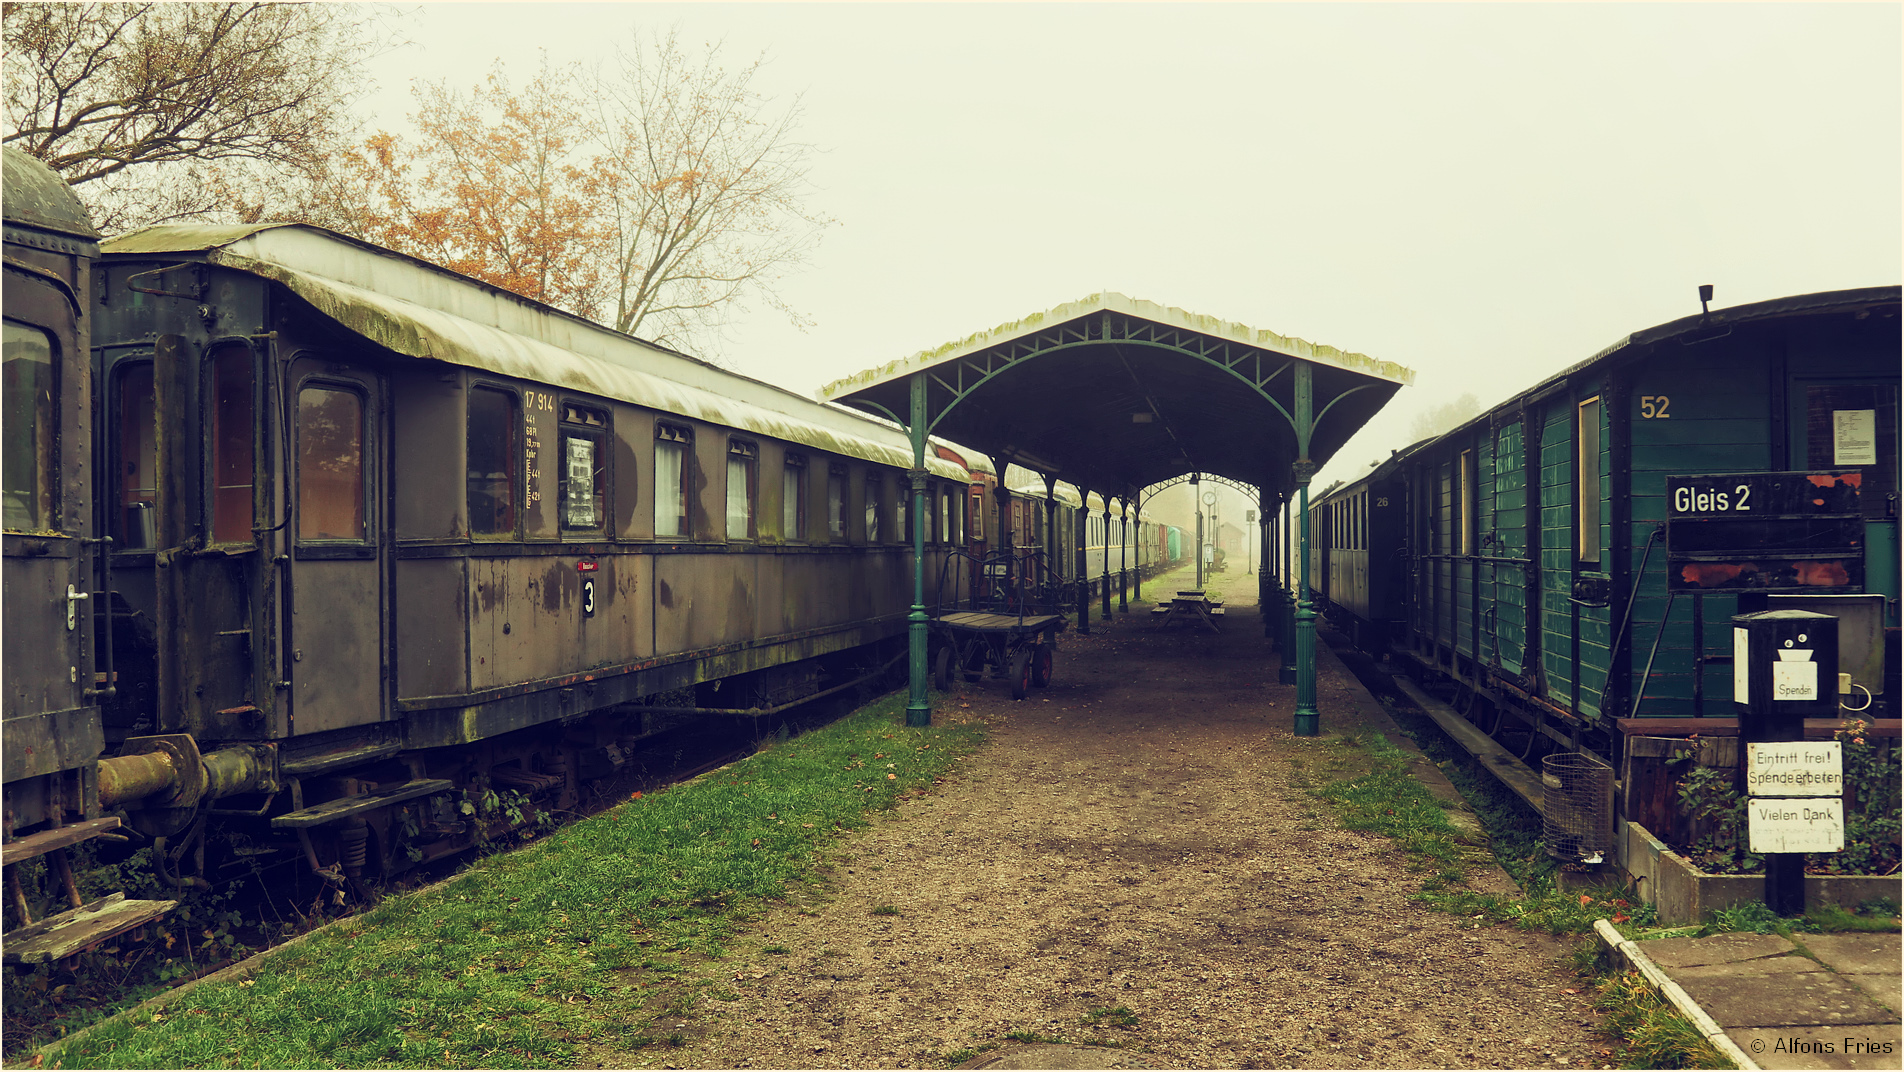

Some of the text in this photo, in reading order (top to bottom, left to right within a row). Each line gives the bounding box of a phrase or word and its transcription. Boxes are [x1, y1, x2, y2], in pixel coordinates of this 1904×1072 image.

[525, 390, 553, 413] 17 914
[1641, 395, 1670, 419] 52
[1376, 496, 1389, 507] 26
[1675, 484, 1751, 512] Gleis 2
[585, 581, 594, 613] 3
[1779, 684, 1812, 697] Spenden
[1757, 751, 1831, 765] Eintritt frei!
[1759, 807, 1835, 820] Vielen Dank
